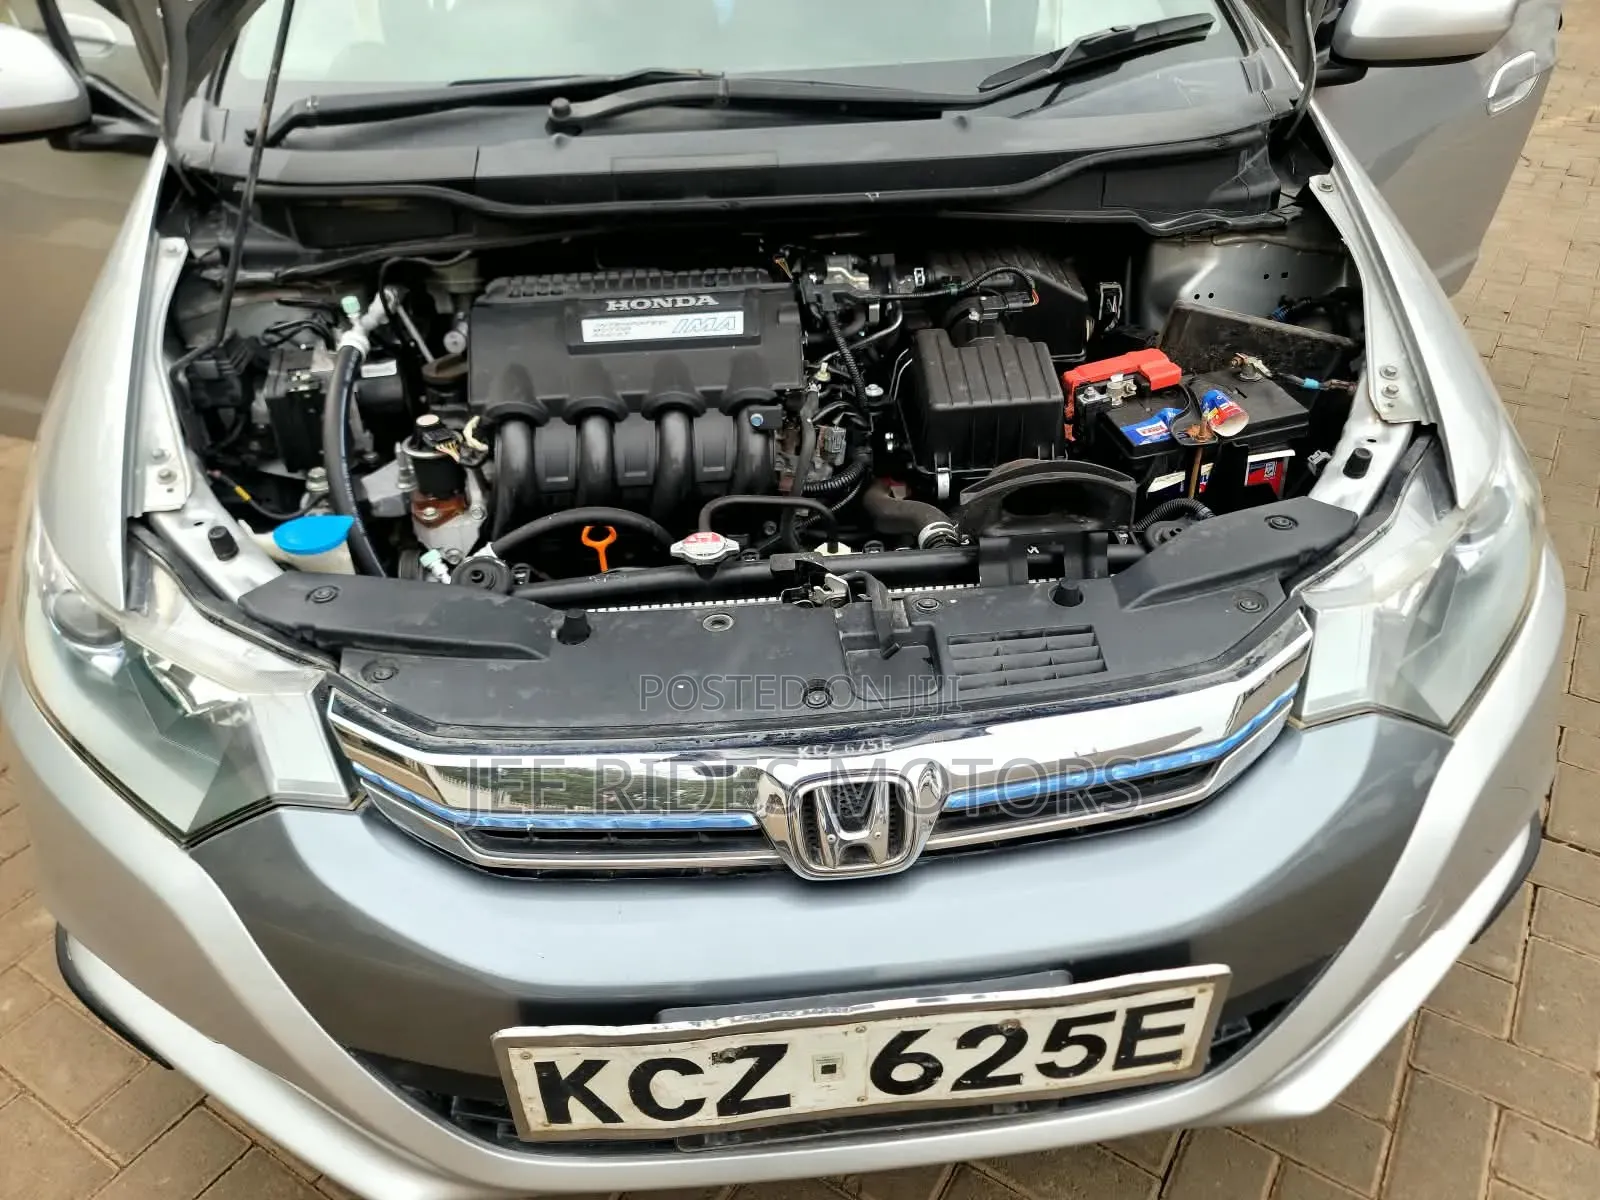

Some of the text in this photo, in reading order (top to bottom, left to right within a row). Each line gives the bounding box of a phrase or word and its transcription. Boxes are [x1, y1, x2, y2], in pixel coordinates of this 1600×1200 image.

[606, 296, 719, 312] HONDA
[672, 316, 737, 334] IMA
[535, 997, 1196, 1125] KCZ 625E
